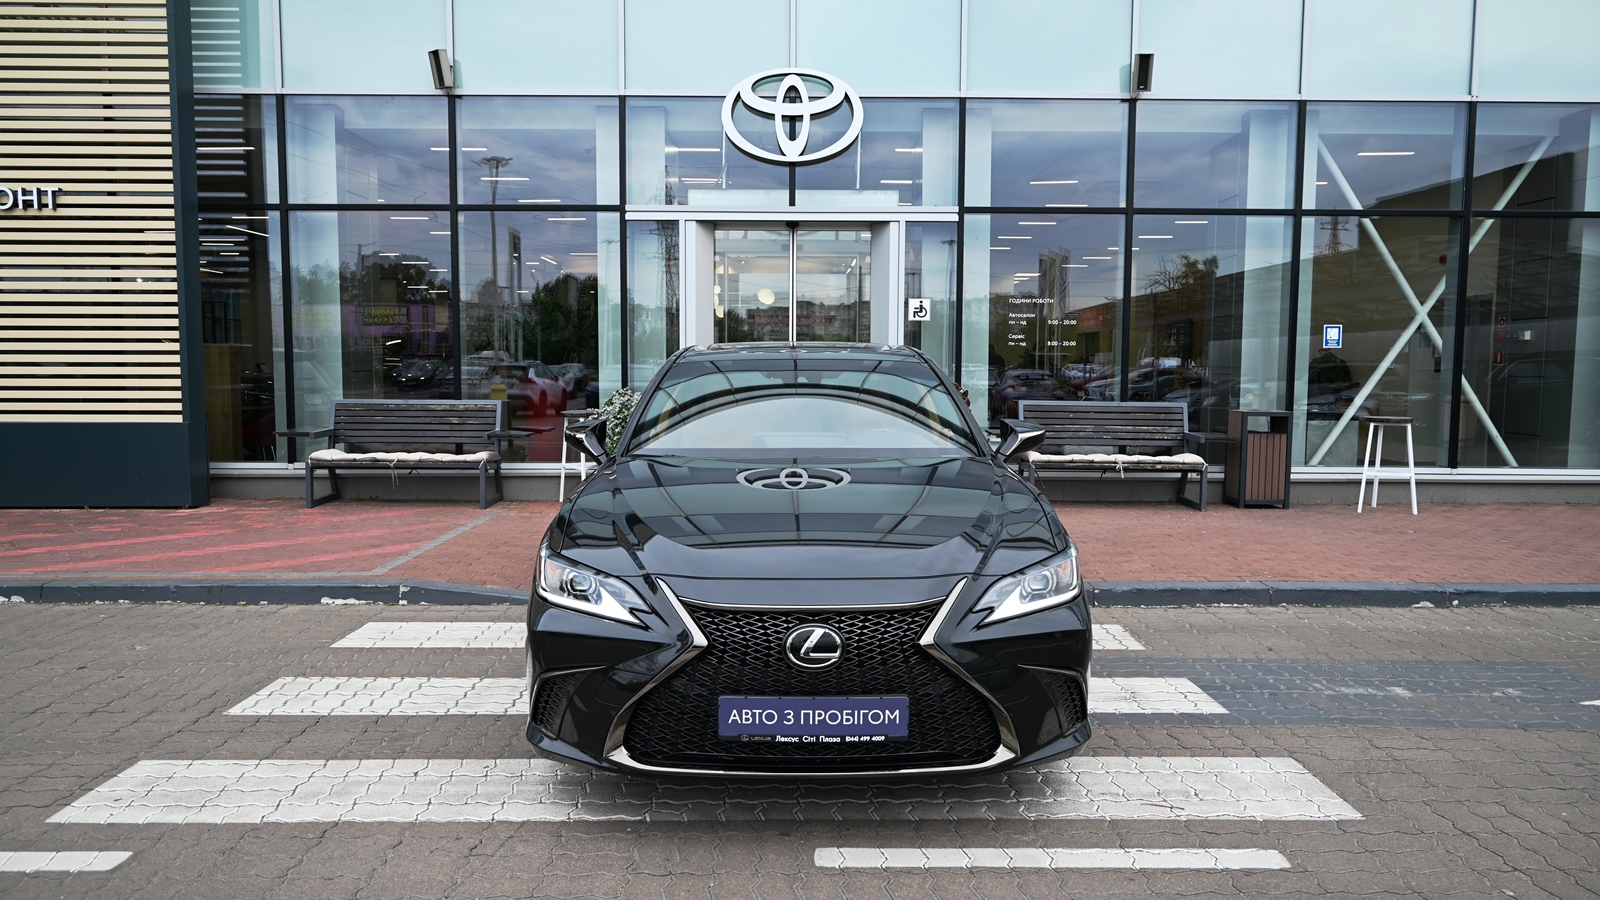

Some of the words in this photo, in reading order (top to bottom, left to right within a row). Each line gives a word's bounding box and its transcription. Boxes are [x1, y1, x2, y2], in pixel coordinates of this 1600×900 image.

[728, 709, 778, 725] АВТО
[783, 709, 795, 725] З
[800, 709, 900, 725] ПРОБІГОМ
[775, 735, 800, 743] Лексус
[802, 735, 816, 743] Сіті
[819, 735, 841, 743] Плаза
